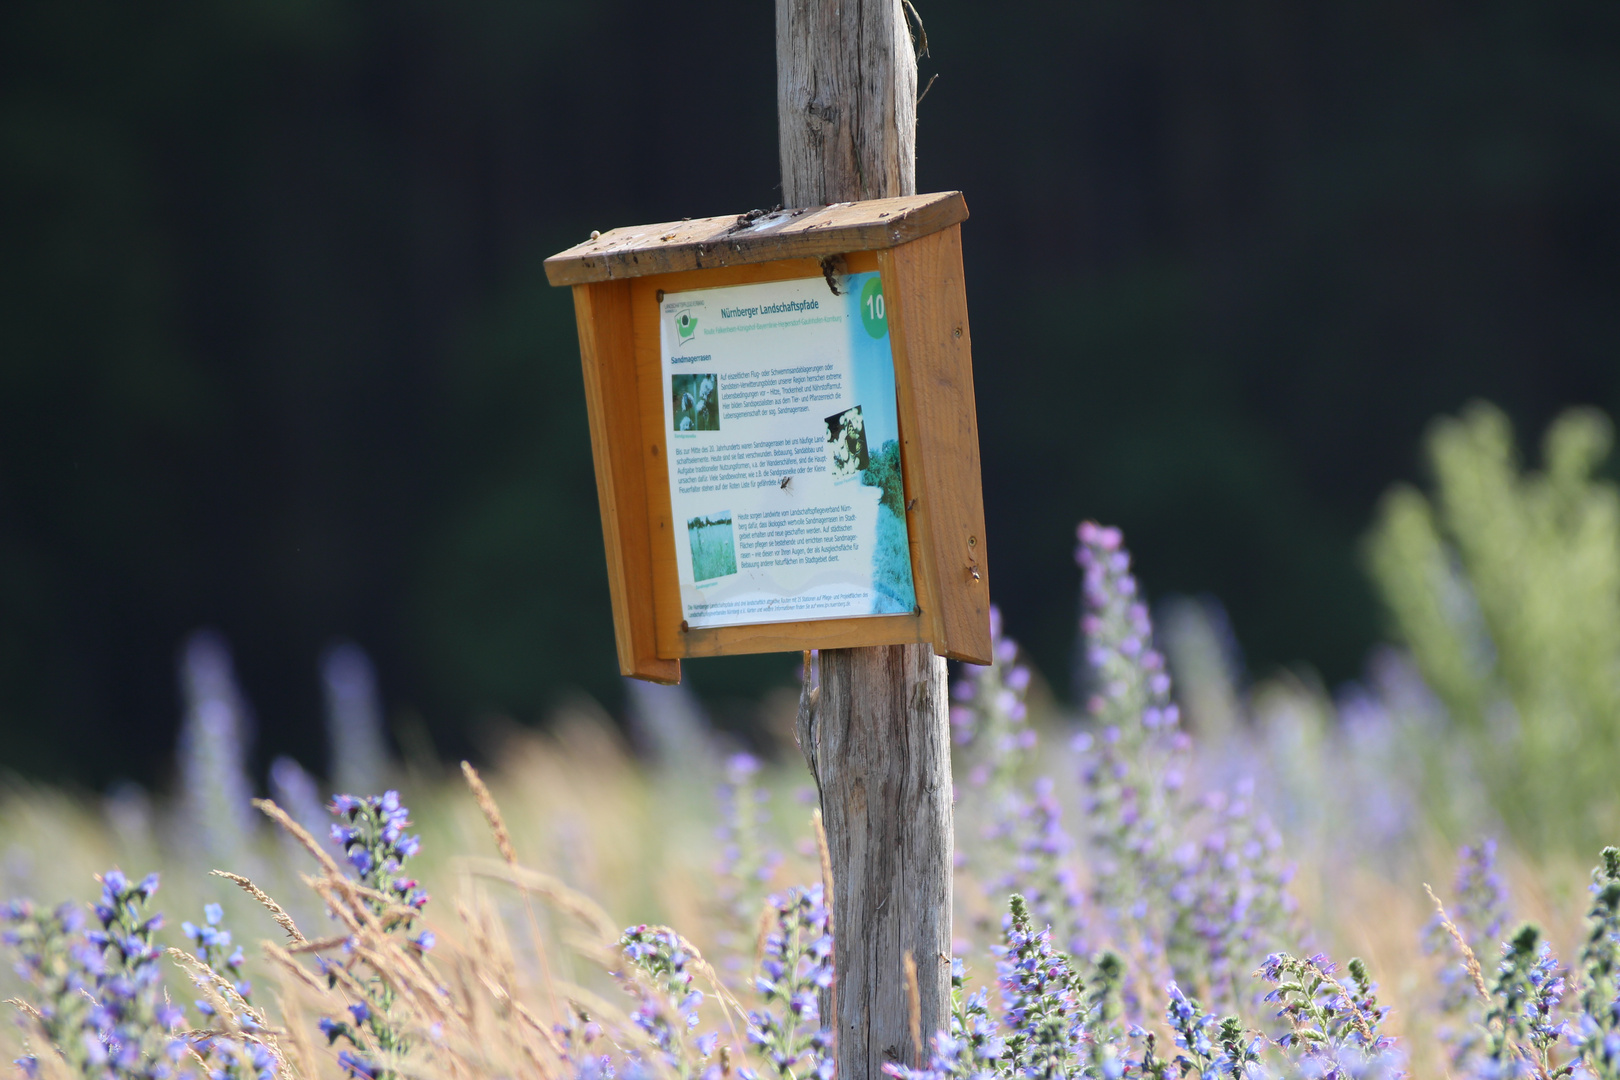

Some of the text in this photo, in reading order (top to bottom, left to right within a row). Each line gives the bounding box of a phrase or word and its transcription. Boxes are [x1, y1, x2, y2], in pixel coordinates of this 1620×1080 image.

[721, 299, 819, 318] Nürnberger Landschaftspfade
[866, 294, 885, 320] 10
[671, 354, 711, 365] Sandmagerrasen
[728, 371, 750, 379] eiszeitlichen
[751, 370, 760, 378] Flug-
[793, 376, 806, 385] Region
[807, 374, 825, 382] herrschen
[722, 390, 758, 399] Lebensbedingungen
[781, 385, 803, 394] Trockenheit
[809, 392, 834, 401] Pflanzenreich
[723, 408, 761, 419] Lebensgemeinschaft
[716, 442, 740, 451] Jahrhunderts
[753, 440, 784, 449] Sandmagerrasen
[799, 436, 813, 445] häufige
[794, 446, 815, 454] Sandabbau
[677, 465, 694, 475] Aufgabe
[695, 463, 718, 472] traditioneller
[678, 475, 697, 483] ursachen
[770, 466, 796, 477] Sandgrasnelke
[679, 484, 700, 493] Feuerfalter
[757, 478, 776, 488] gefährdete
[763, 509, 781, 517] Landwirte
[790, 505, 840, 516] Landschaftspflegeverband
[738, 522, 747, 530] berg
[768, 519, 786, 528] ökologisch
[788, 518, 804, 526] wertvolle
[806, 516, 838, 525] Sandmagerrasen
[739, 531, 751, 540] gebiet
[785, 527, 805, 537] geschaffen
[830, 524, 852, 532] städtischen
[755, 540, 768, 549] pflegen
[775, 537, 796, 546] bestehende
[821, 543, 852, 554] Ausgleichsfläche
[741, 560, 760, 568] Bebauung
[775, 557, 798, 565] Naturflächen
[805, 555, 827, 564] Stadtgebiet
